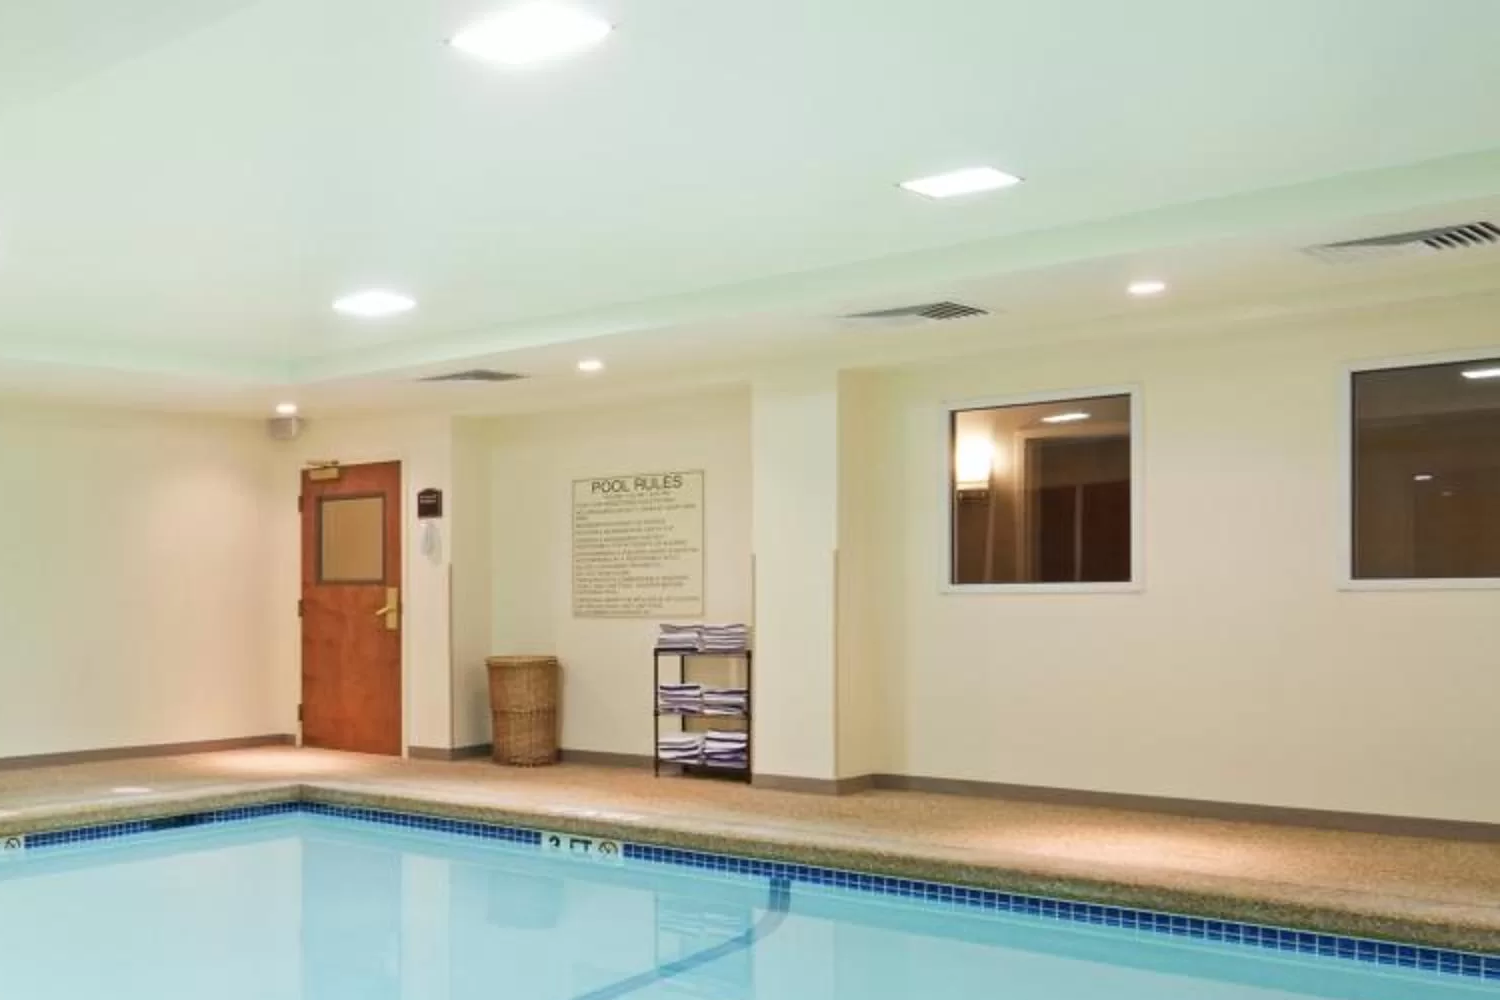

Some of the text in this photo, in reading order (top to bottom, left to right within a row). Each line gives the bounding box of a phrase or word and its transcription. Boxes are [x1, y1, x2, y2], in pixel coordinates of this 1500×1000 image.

[591, 475, 683, 494] POOL RULES
[570, 838, 592, 853] FT
